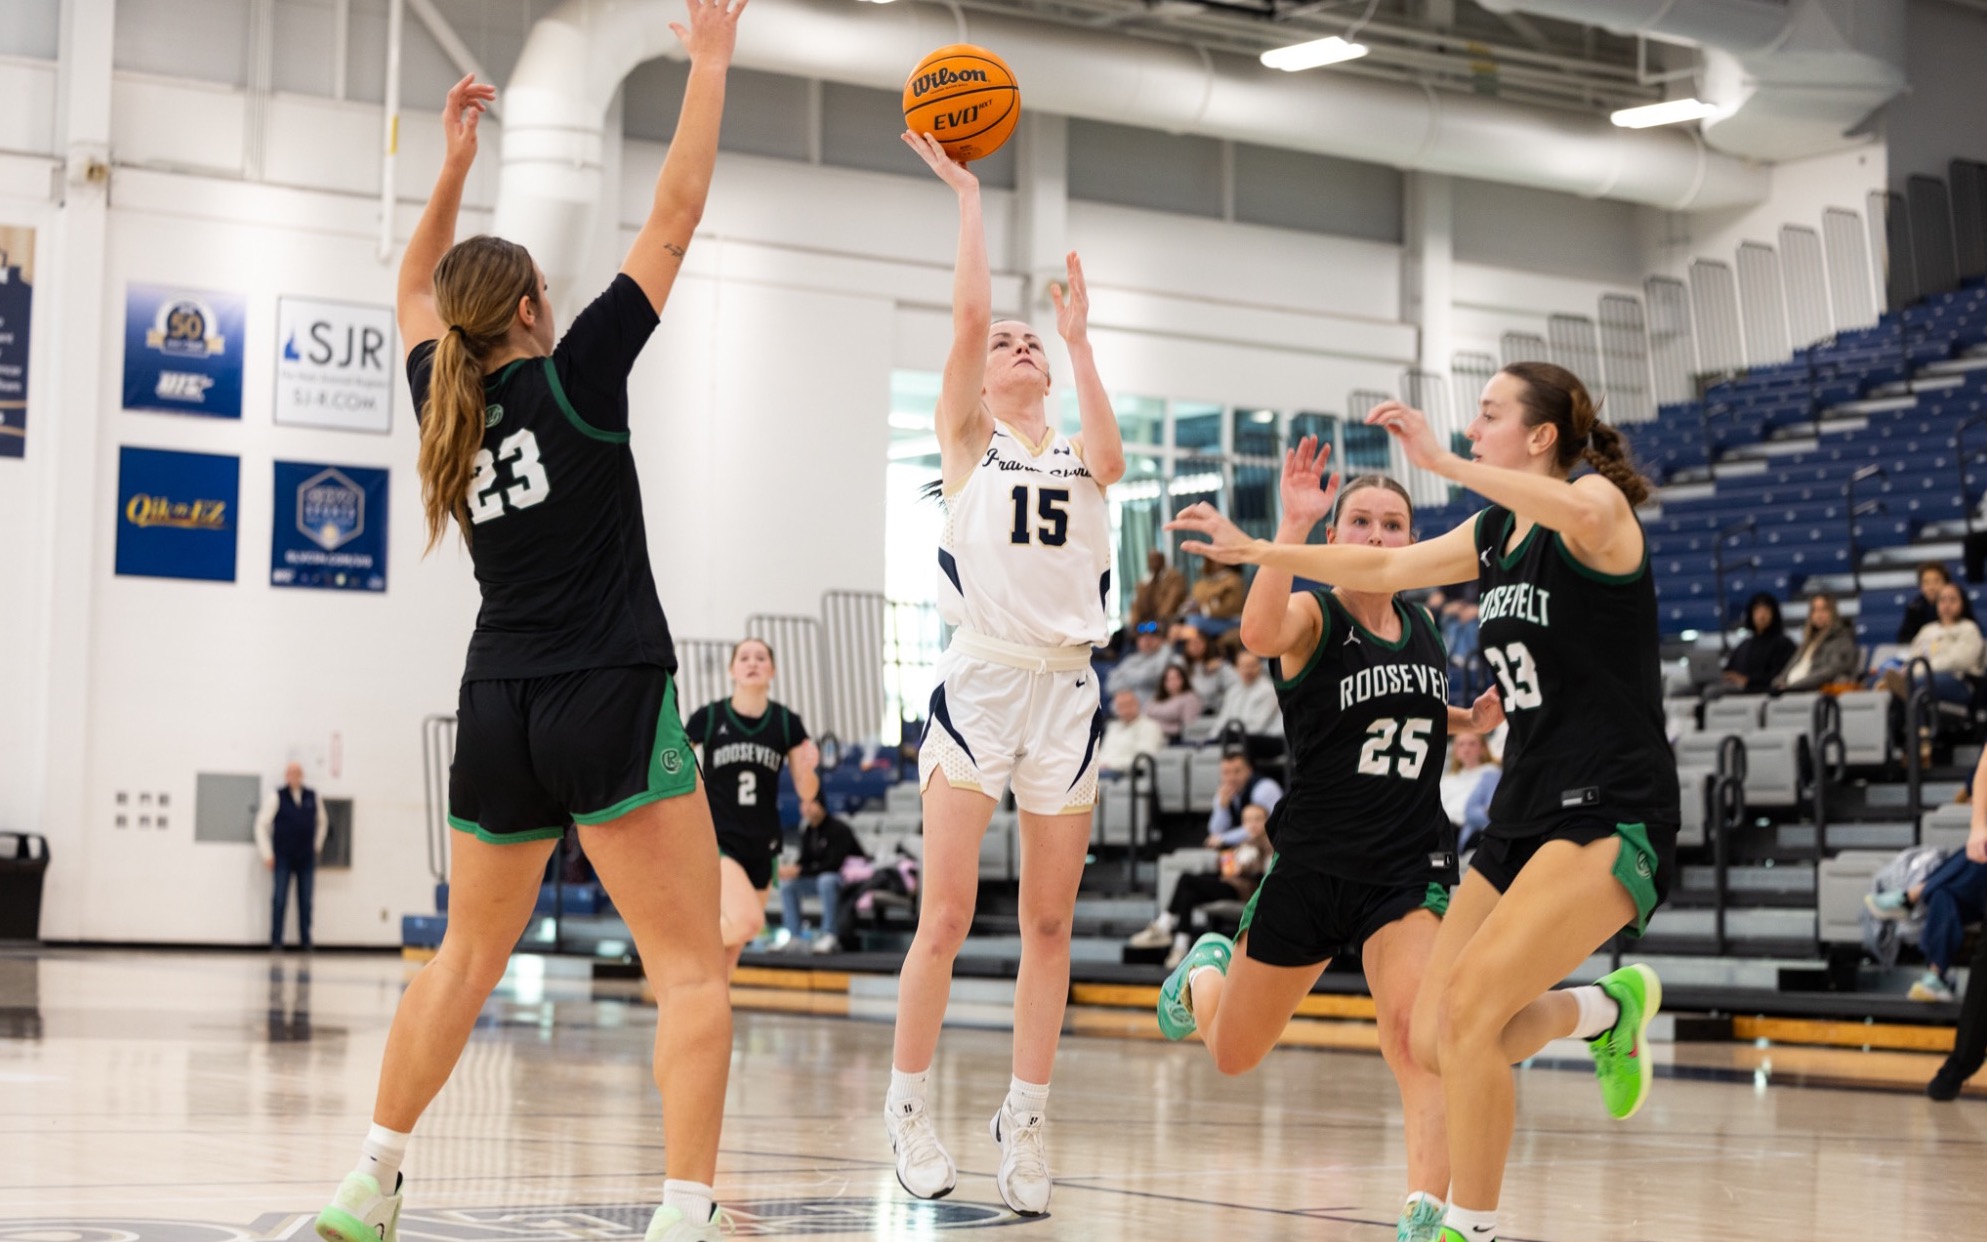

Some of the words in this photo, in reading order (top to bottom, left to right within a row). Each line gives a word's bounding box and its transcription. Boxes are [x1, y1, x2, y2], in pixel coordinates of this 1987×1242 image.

[912, 67, 987, 97] Wilson
[934, 104, 978, 130] EVO
[170, 312, 203, 340] 50
[308, 321, 384, 371] SJR
[467, 428, 550, 525] 23
[1010, 485, 1070, 548] 15
[1358, 717, 1432, 780] 25
[738, 770, 756, 805] 2
